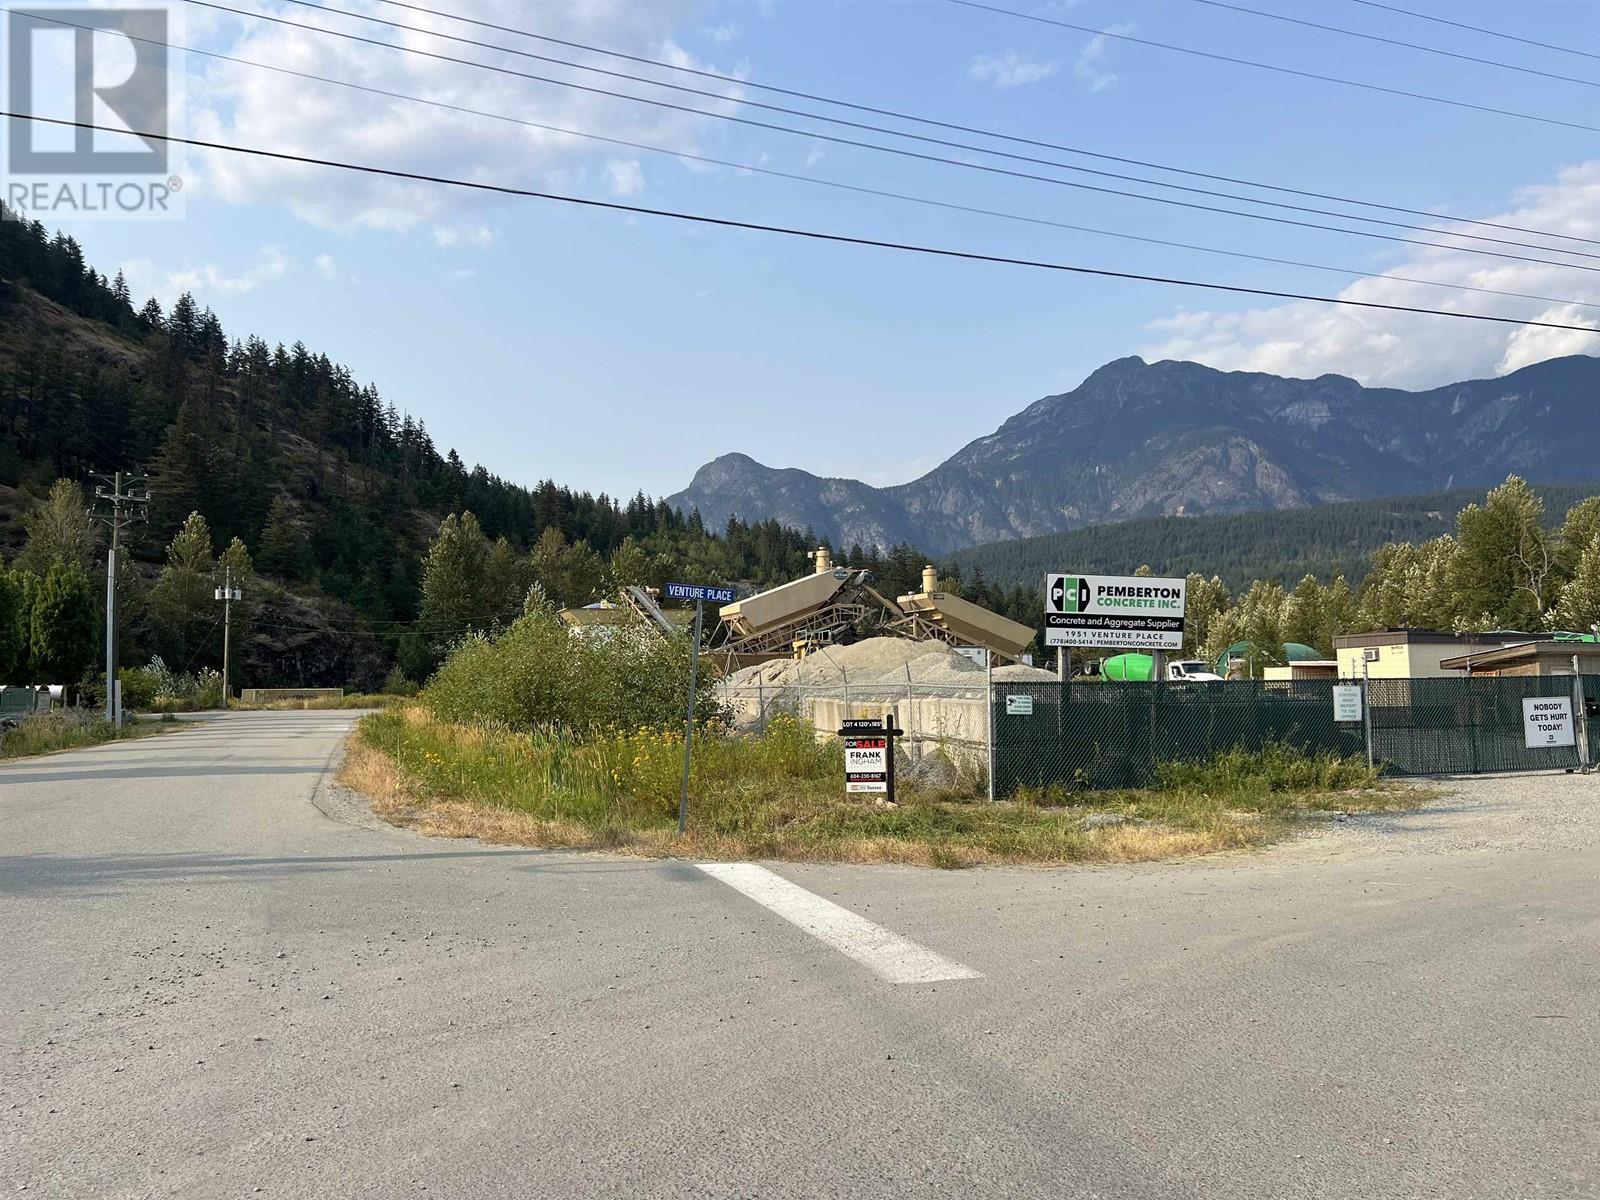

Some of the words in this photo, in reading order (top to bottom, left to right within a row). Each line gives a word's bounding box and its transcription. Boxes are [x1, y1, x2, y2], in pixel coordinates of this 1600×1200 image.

[669, 585, 705, 599] VENTURE
[707, 589, 732, 601] PLACE
[1053, 588, 1087, 602] PCI
[1097, 586, 1180, 599] PEMBERTON
[1097, 597, 1155, 608] CONCRETE
[1158, 600, 1180, 609] INC.
[1049, 615, 1086, 625] Concrete
[1087, 617, 1103, 626] and
[1104, 618, 1146, 629] Aggregate
[1147, 619, 1180, 629] Supplier
[1091, 631, 1132, 639] VENTURE
[1096, 640, 1178, 648] PEMBERTONCONCRETE.COM
[1534, 703, 1563, 711] NOBODY
[1530, 714, 1549, 722] GETS
[1550, 713, 1568, 721] HURT
[856, 740, 885, 748] SALE
[850, 751, 881, 759] FRANK
